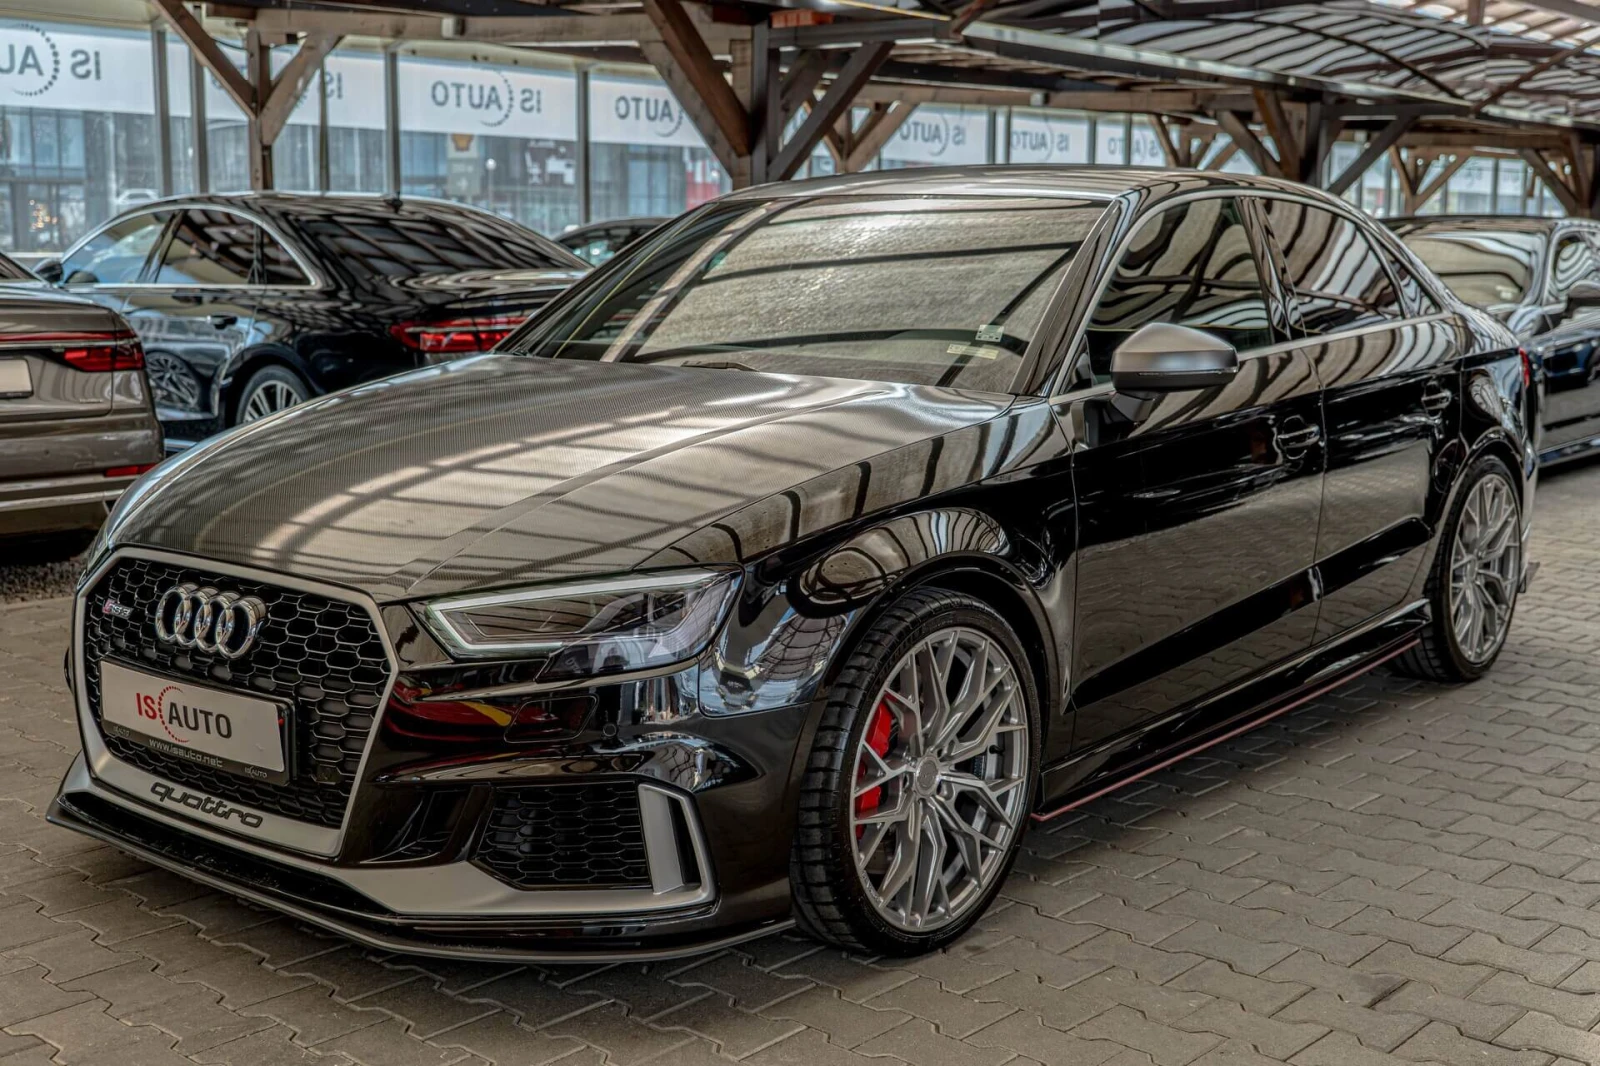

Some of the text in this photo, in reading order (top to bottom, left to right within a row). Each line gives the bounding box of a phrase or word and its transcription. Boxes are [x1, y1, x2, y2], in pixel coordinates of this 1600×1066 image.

[136, 692, 232, 739] IS AUTO
[149, 738, 223, 768] www.isauto.net
[150, 781, 263, 829] quattro
